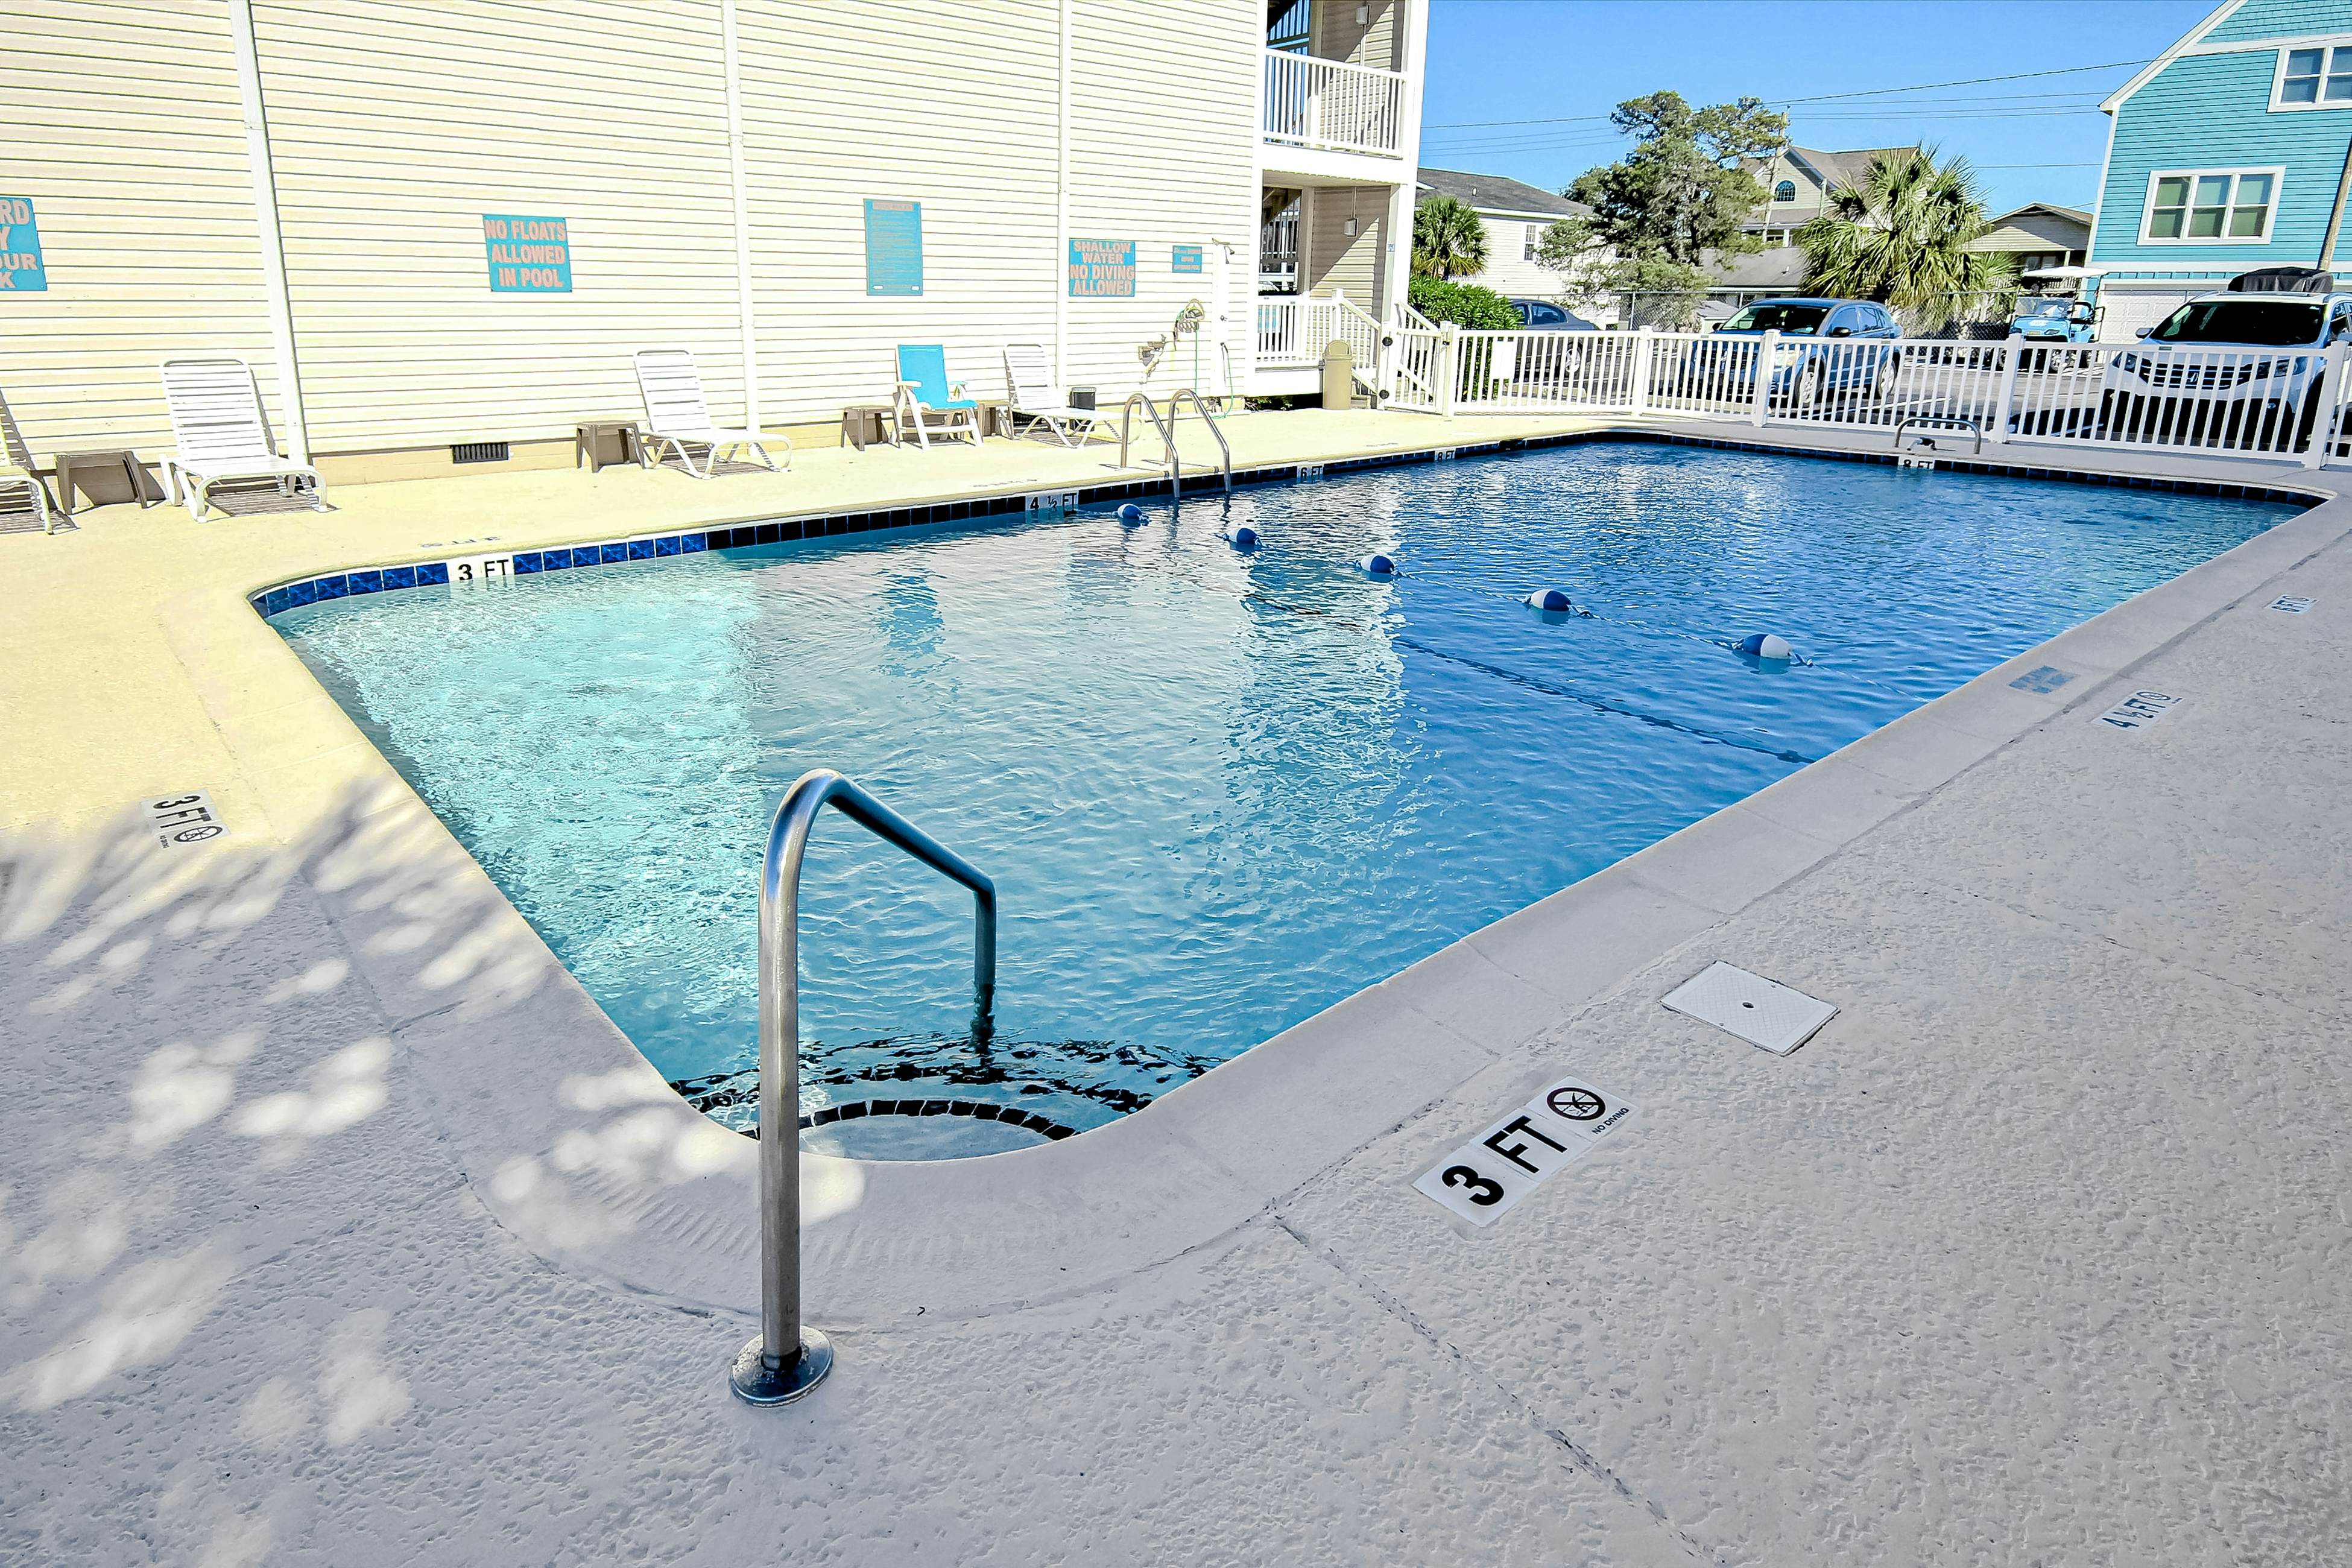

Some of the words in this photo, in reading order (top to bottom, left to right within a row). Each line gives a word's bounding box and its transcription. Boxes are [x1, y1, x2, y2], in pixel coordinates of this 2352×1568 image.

[484, 220, 507, 239] NO
[511, 221, 567, 241] FLOATS
[492, 244, 566, 264] ALLOWED
[1074, 241, 1131, 252] SHALLOW
[1083, 253, 1124, 264] WATER
[499, 268, 517, 286] IN
[520, 268, 563, 287] POOL
[1070, 265, 1088, 279] NO
[1092, 265, 1134, 280] DIVING
[1073, 280, 1132, 295] ALLOWED
[1438, 452, 1443, 461] 8
[1446, 450, 1455, 460] FT
[1301, 467, 1307, 478] 6
[1311, 466, 1322, 476] FT
[1918, 461, 1933, 469] FT
[1030, 497, 1039, 510] 4
[1063, 493, 1077, 507] FT
[458, 564, 472, 581] 3
[484, 559, 509, 577] FT
[2102, 718, 2140, 728] 4
[2124, 698, 2166, 713] FT
[153, 795, 201, 809] 3
[156, 807, 212, 828] FT
[1592, 1125, 1605, 1134] NO
[1603, 1108, 1630, 1126] DIVING
[1442, 1165, 1504, 1206] 3
[1483, 1116, 1568, 1174] FT
